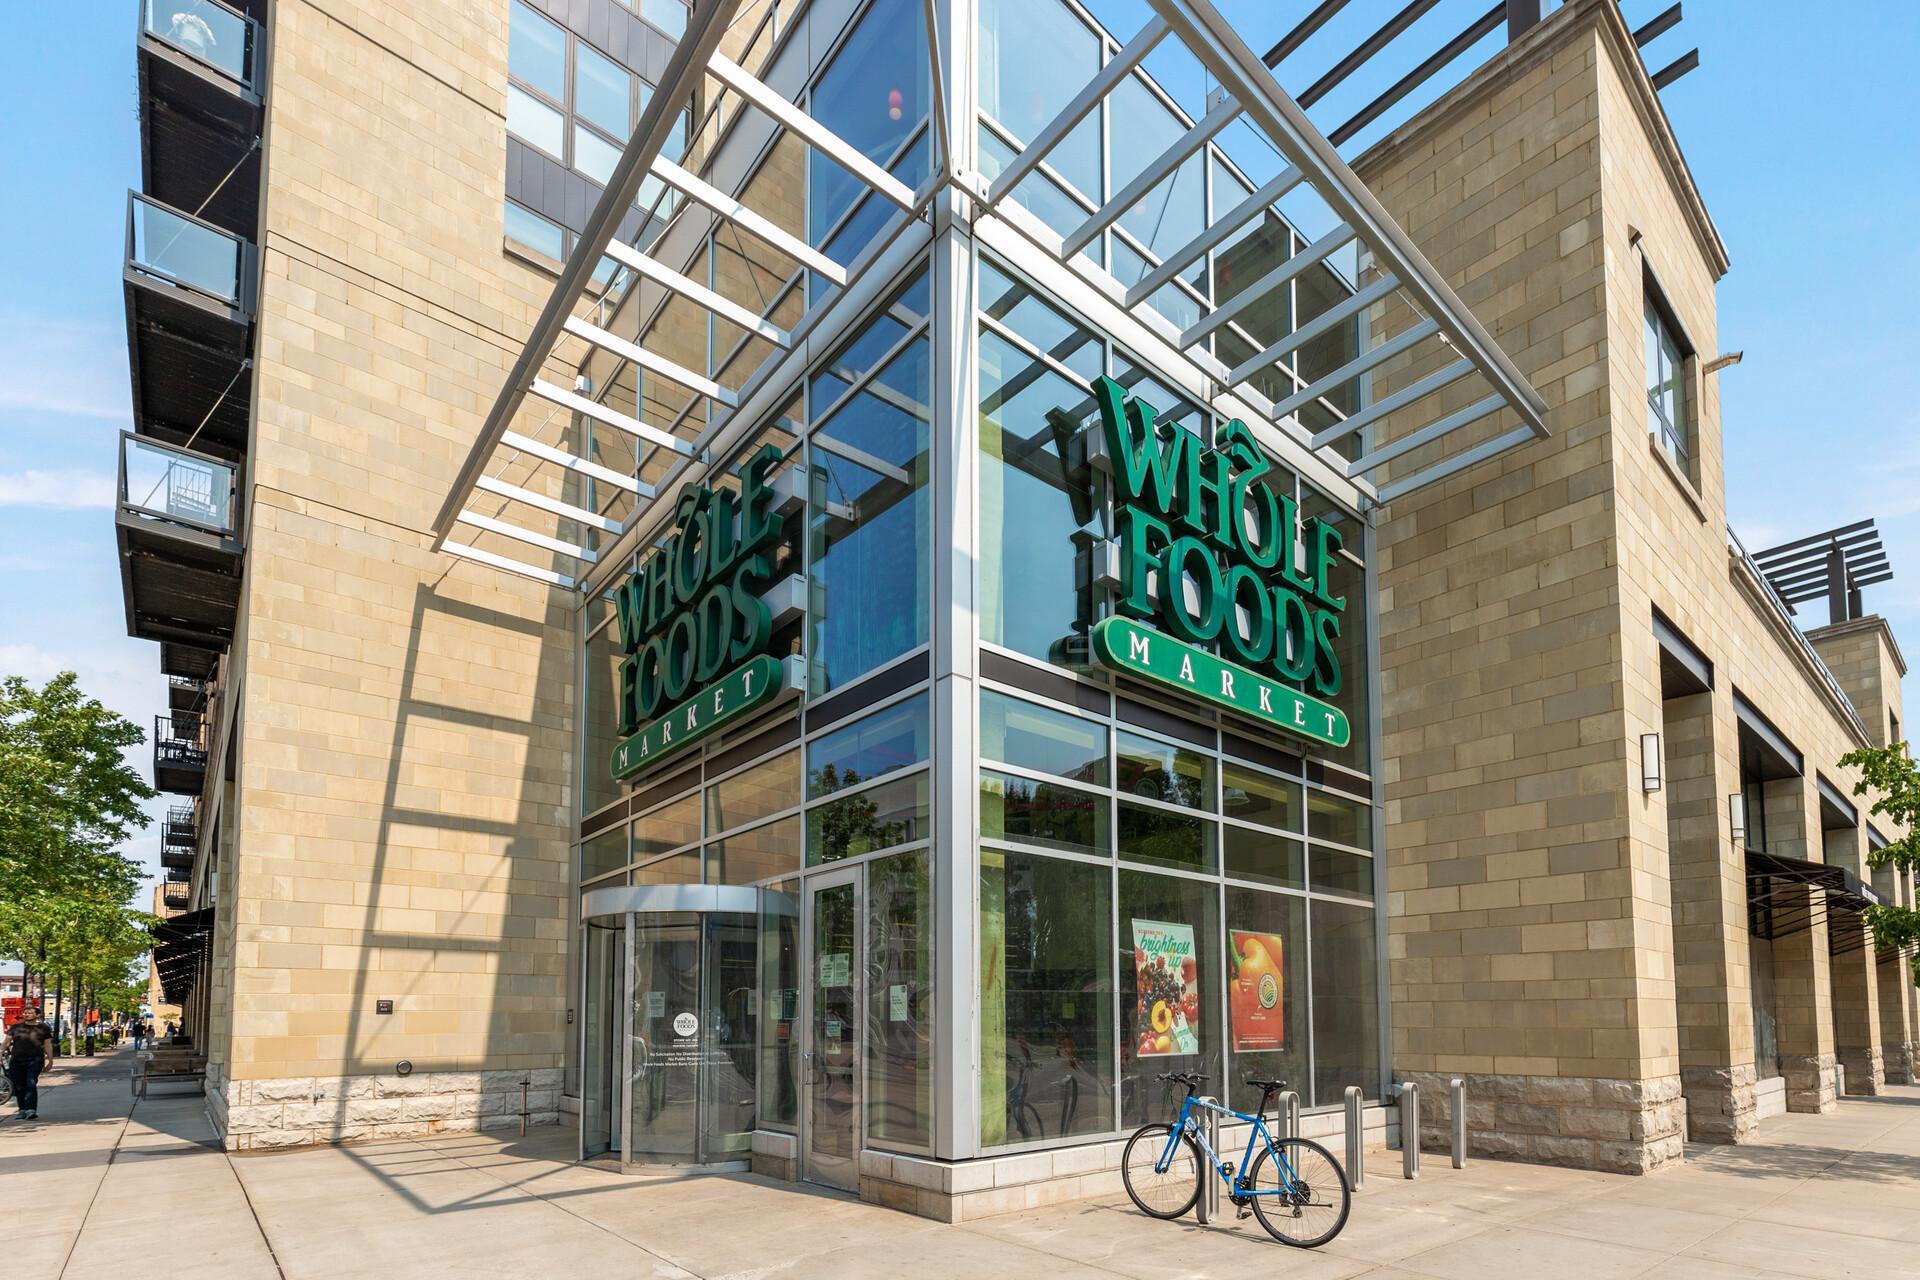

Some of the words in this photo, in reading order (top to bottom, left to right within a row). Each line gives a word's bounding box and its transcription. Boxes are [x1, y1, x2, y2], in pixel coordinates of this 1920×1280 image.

[613, 443, 786, 654] WHOLE
[1091, 375, 1346, 612] WHOLE
[617, 553, 773, 737] FOODS
[1115, 504, 1342, 697] FOODS
[618, 669, 755, 770] MARKET
[1129, 630, 1337, 738] MARKET
[1139, 933, 1191, 961] brightness
[1167, 955, 1182, 969] up
